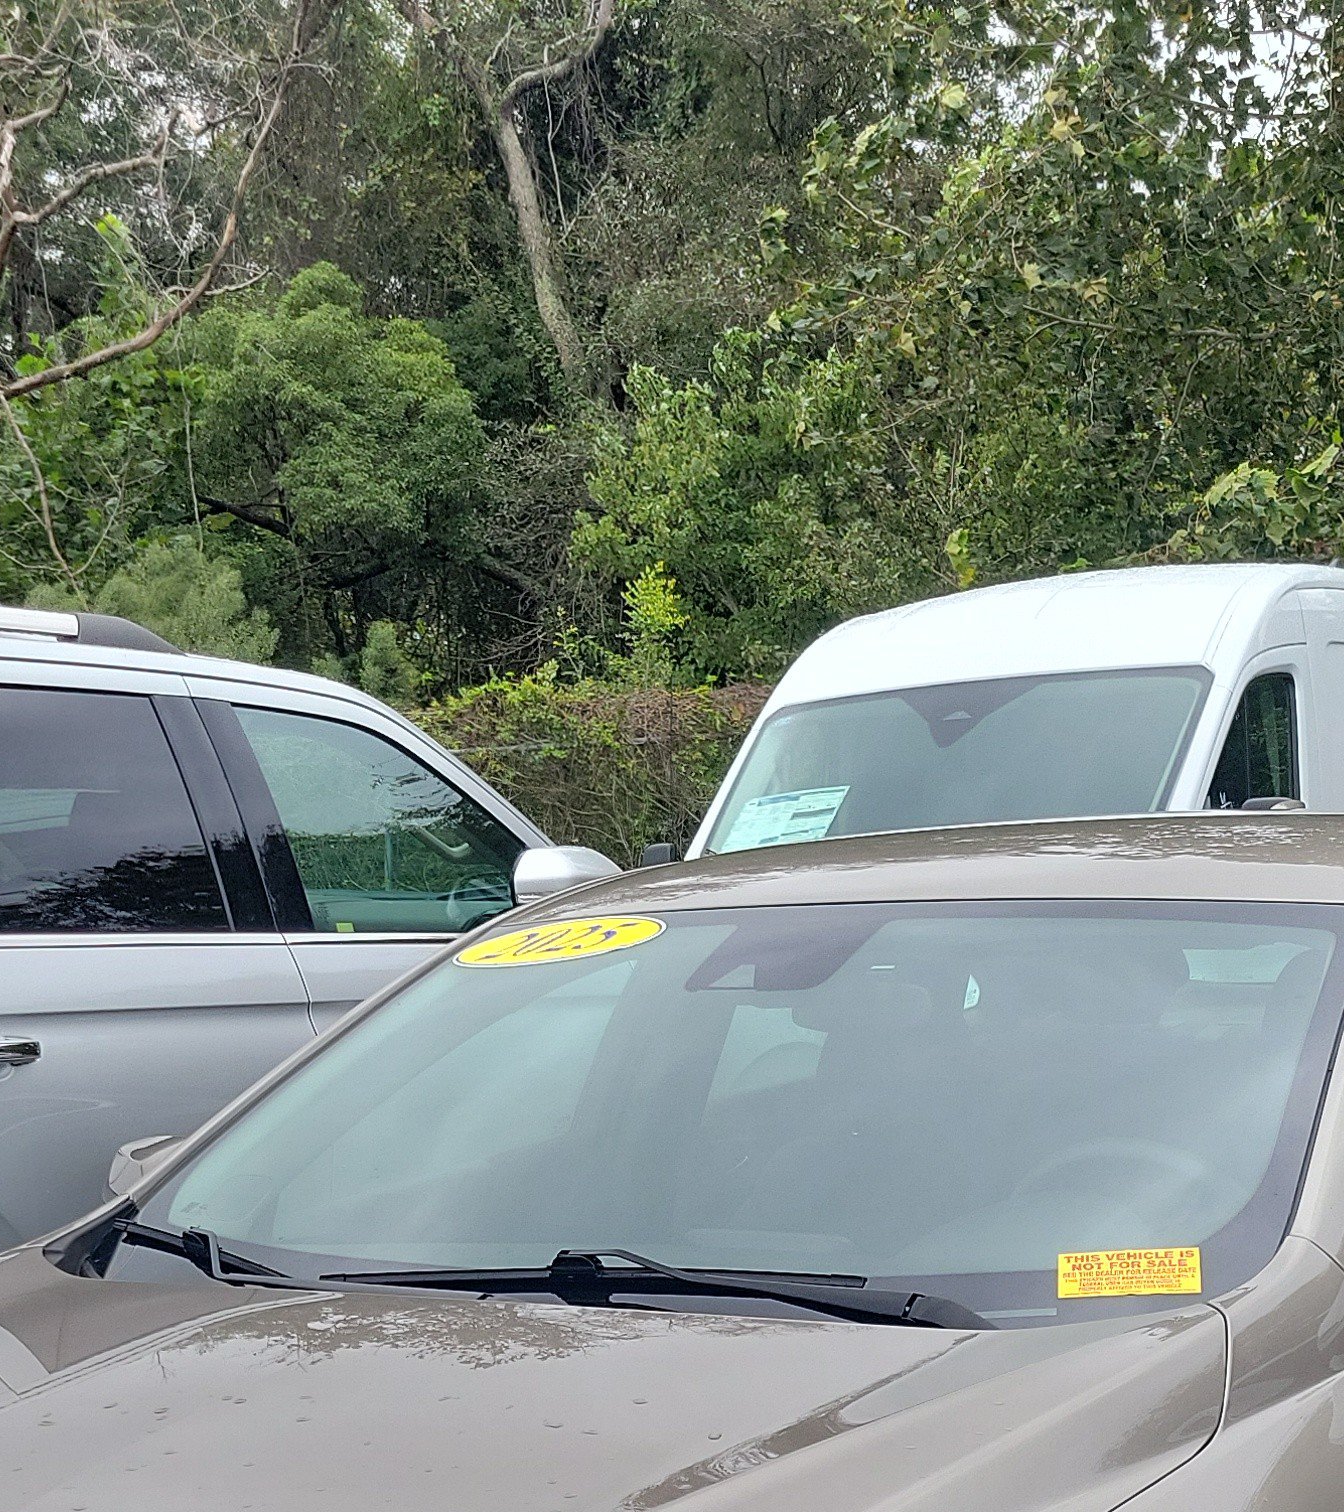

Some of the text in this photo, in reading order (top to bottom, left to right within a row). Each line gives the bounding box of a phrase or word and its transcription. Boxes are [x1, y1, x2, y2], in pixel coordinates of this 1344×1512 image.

[474, 921, 641, 962] 2025
[1064, 1250, 1195, 1264] THIS VEHICLE IS
[1071, 1258, 1188, 1271] NOT FOR SALE
[1096, 1269, 1124, 1277] DEALER
